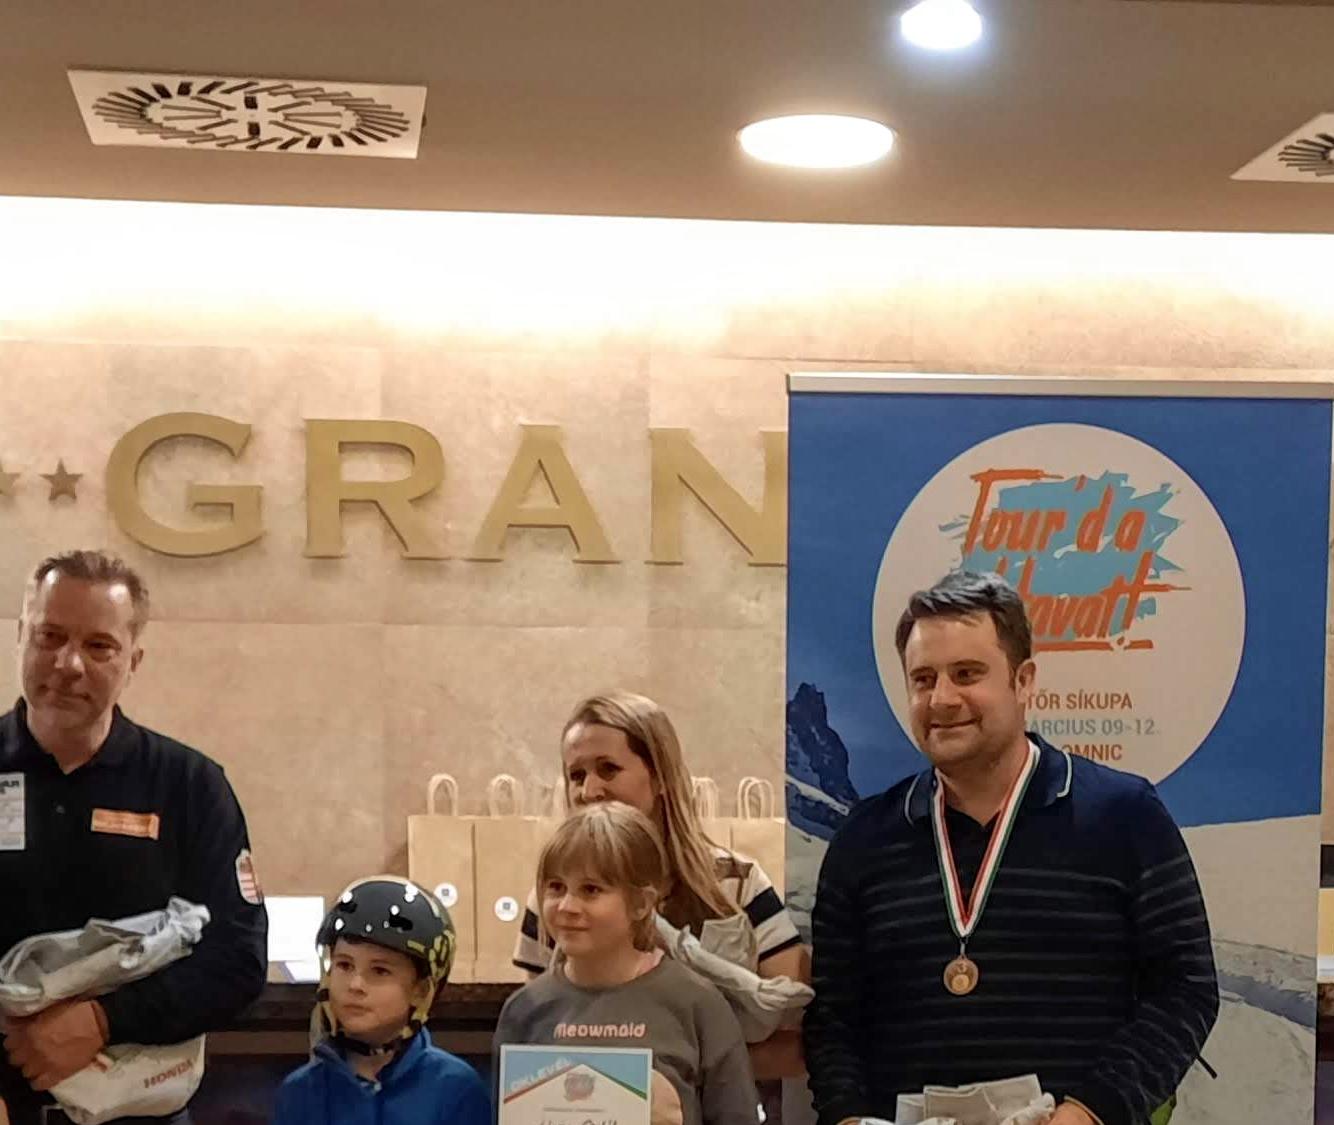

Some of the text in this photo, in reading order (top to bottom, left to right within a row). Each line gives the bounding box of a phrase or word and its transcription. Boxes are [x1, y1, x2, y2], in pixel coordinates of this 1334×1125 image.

[1066, 689, 1133, 710] SÍKUPA
[1024, 714, 1097, 736] ÁRCIUS
[143, 1059, 196, 1089] HONDA
